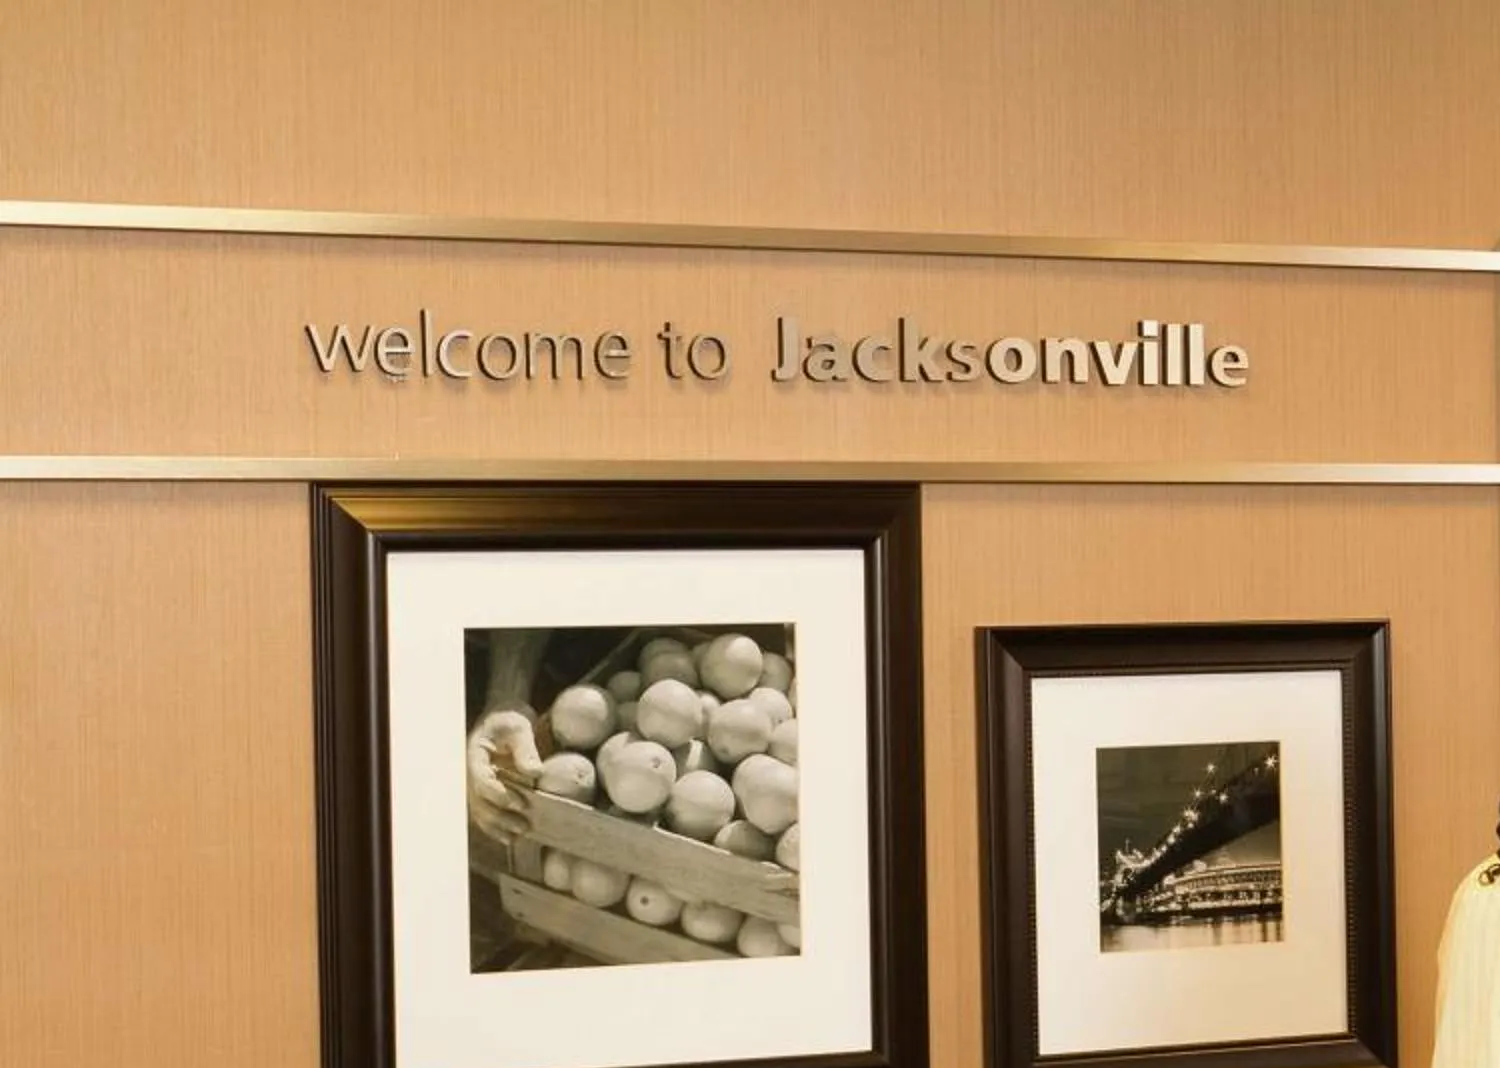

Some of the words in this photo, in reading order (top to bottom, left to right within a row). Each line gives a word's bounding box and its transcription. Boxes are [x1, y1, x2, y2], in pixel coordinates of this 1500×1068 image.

[305, 308, 632, 381] welcome
[657, 321, 729, 381] to
[769, 317, 1250, 387] Jacksonville
